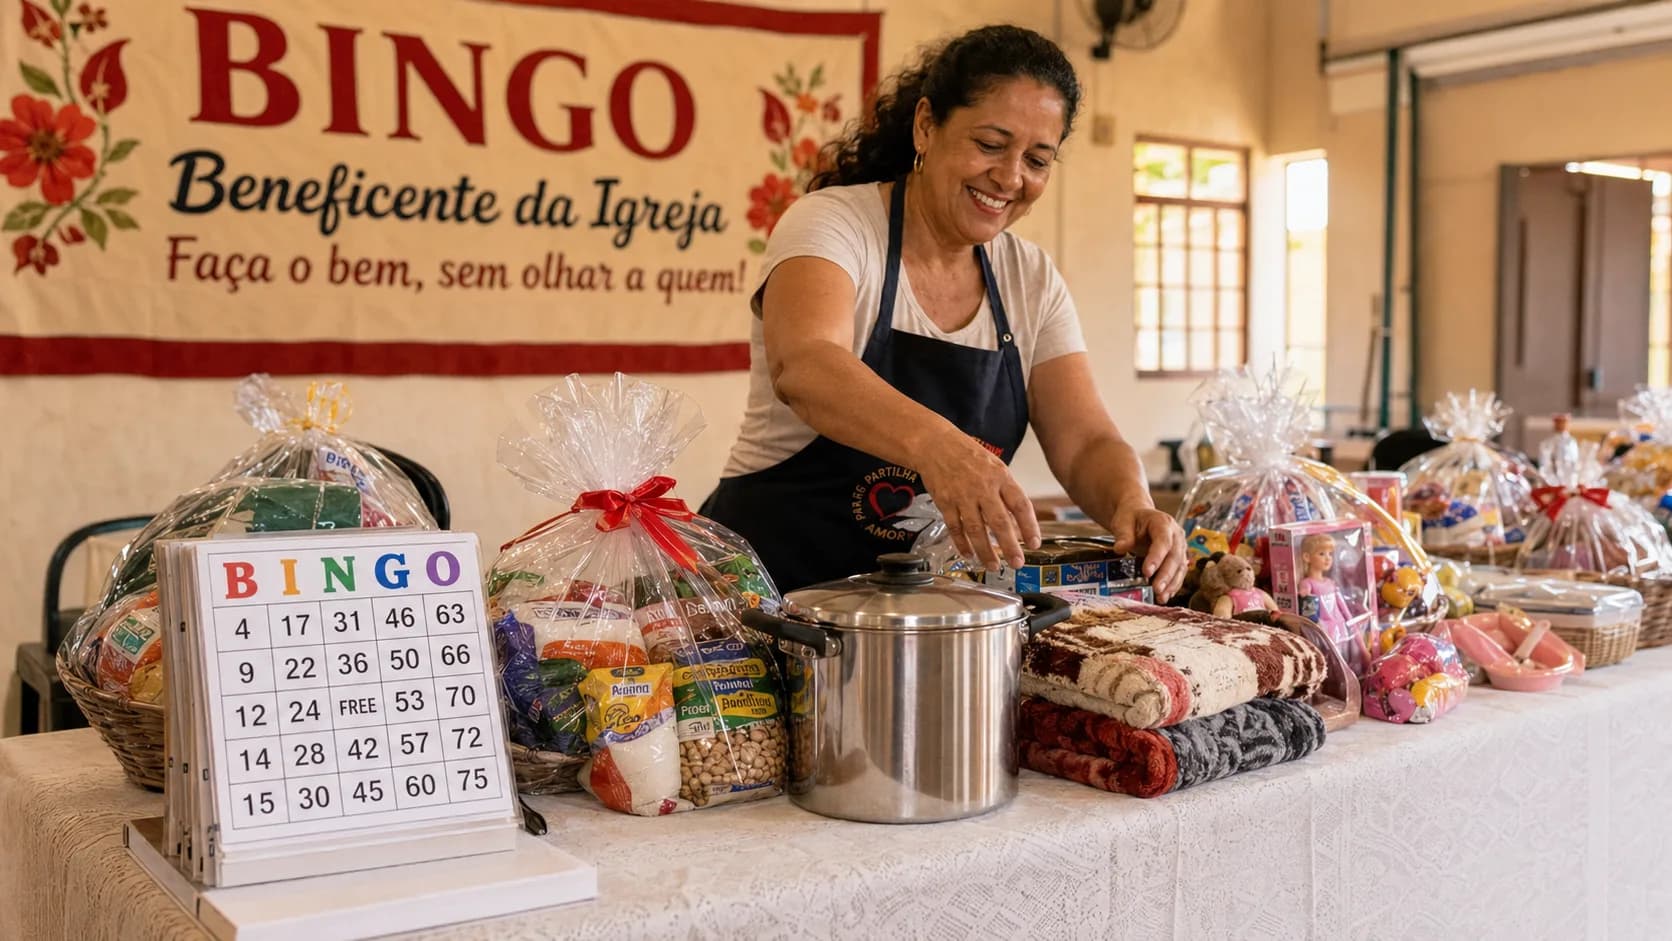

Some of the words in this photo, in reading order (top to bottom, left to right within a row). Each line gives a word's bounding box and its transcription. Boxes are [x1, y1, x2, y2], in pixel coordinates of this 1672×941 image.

[186, 4, 697, 161] BINGO
[169, 149, 501, 237] Beneficente
[515, 179, 577, 229] da
[590, 178, 728, 250] Igreja
[167, 236, 274, 293] Faça
[290, 257, 312, 285] o
[328, 245, 424, 293] bem,
[438, 261, 508, 290] sem
[522, 252, 613, 293] olhar
[626, 269, 645, 292] a
[659, 260, 747, 305] quem!
[864, 466, 917, 484] PARTILHA
[864, 523, 906, 541] AMOR
[222, 550, 461, 599] BINGO
[235, 618, 251, 640] 4
[281, 614, 311, 637] 17
[333, 611, 360, 633] 31
[385, 607, 416, 629] 46
[435, 603, 466, 626] 63
[238, 662, 255, 684] 9
[285, 657, 317, 680] 22
[338, 653, 369, 675] 36
[390, 648, 420, 671] 50
[441, 644, 471, 666] 66
[236, 704, 268, 728] 12
[289, 700, 321, 723] 24
[339, 698, 377, 716] FREE
[395, 690, 425, 713] 53
[446, 685, 476, 708] 70
[240, 748, 272, 772] 14
[294, 743, 326, 767] 28
[348, 738, 379, 761] 42
[400, 732, 430, 756] 57
[452, 727, 483, 750] 72
[244, 792, 275, 816] 15
[298, 786, 330, 810] 30
[353, 780, 384, 803] 45
[406, 774, 436, 798] 60
[457, 768, 489, 792] 75
